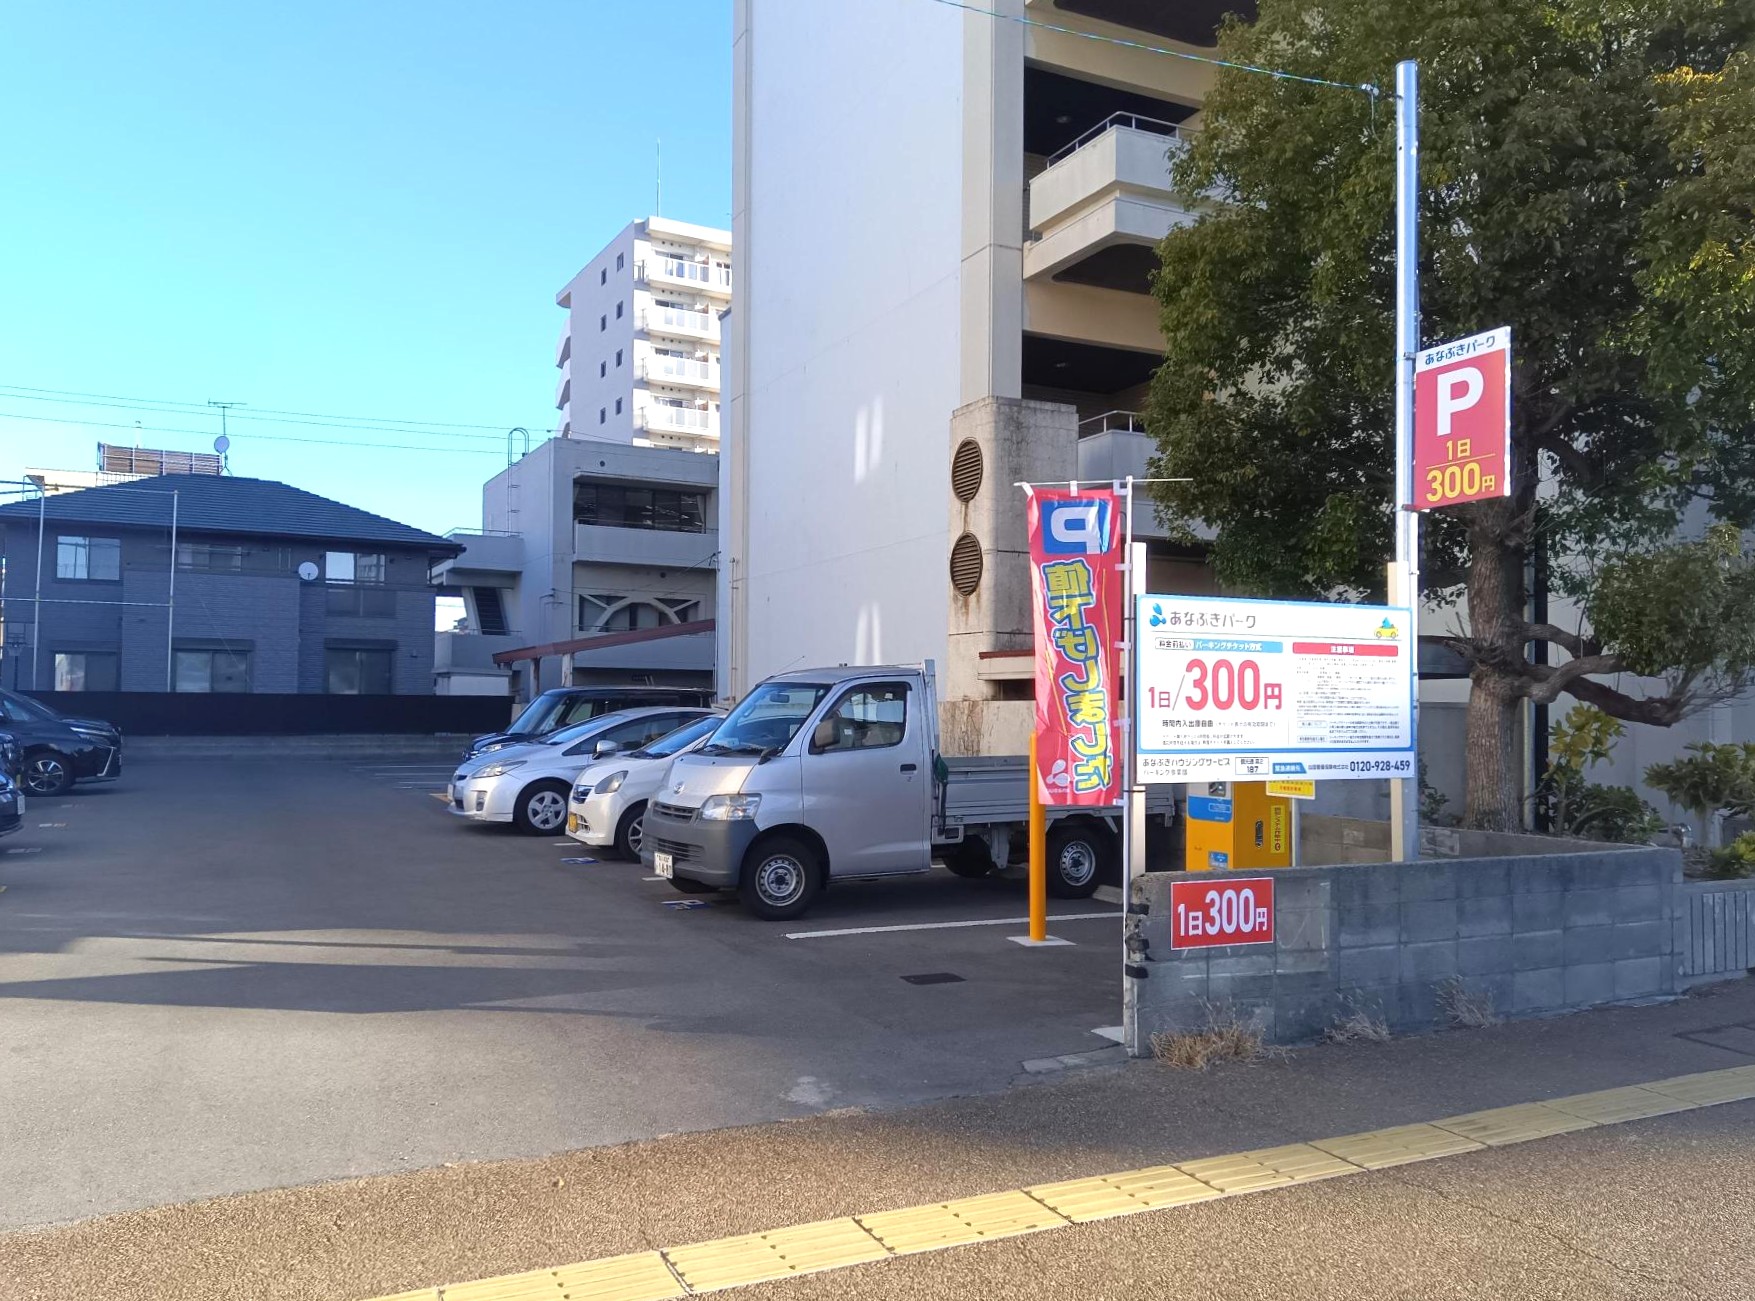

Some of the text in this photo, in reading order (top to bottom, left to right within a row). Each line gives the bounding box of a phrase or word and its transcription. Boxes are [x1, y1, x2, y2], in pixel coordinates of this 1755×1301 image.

[1425, 335, 1496, 365] あなぶきパーク
[1437, 366, 1484, 436] P
[1446, 438, 1471, 461] 1日
[1426, 462, 1496, 502] 300円
[1169, 610, 1257, 628] あなぶきパーク
[1148, 658, 1282, 711] 1日/300円
[1142, 757, 1231, 767] あなぶきハウジングサービス
[1246, 765, 1259, 773] 187
[1350, 760, 1411, 772] 0120-928-459
[1177, 888, 1268, 936] 1日300円
